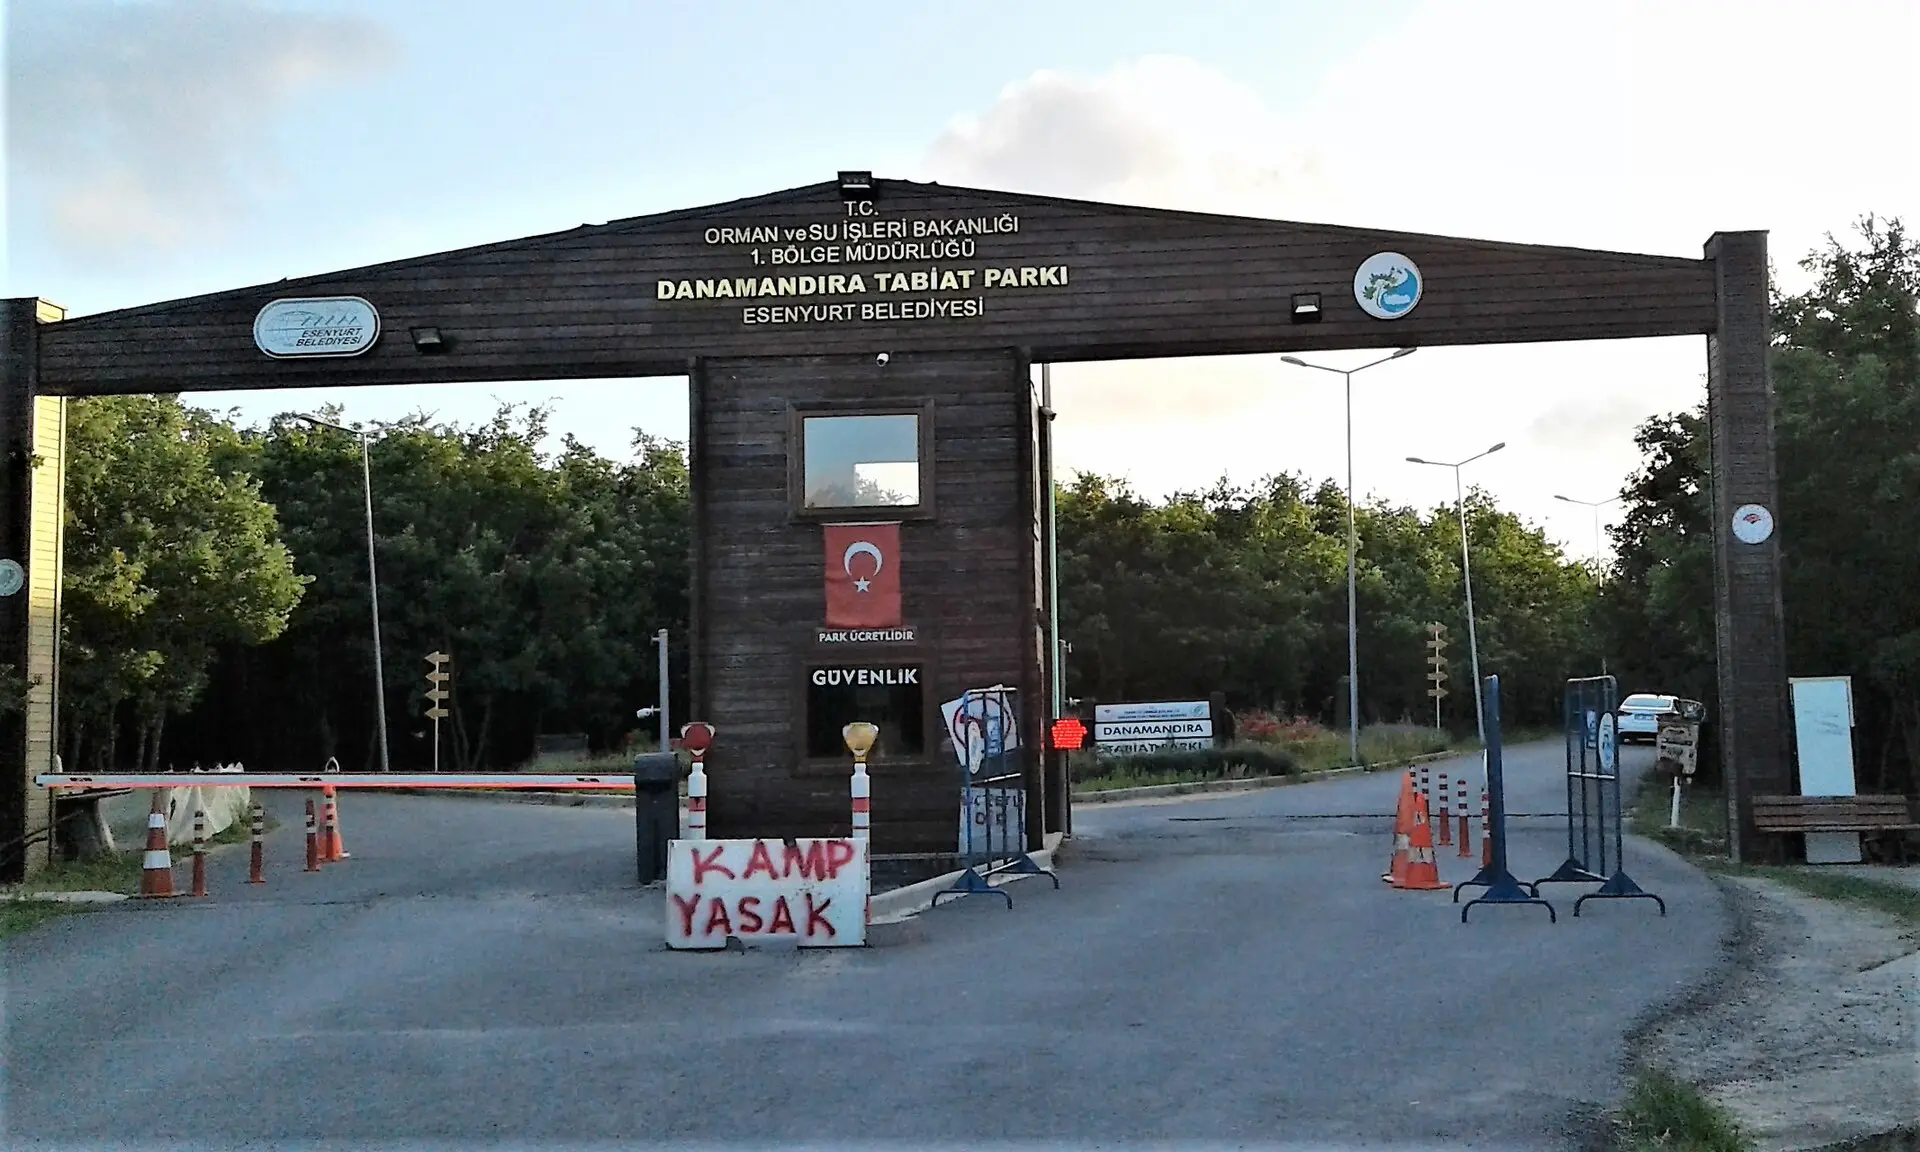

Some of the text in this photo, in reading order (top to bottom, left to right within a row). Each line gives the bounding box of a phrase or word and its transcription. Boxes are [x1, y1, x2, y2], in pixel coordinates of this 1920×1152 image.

[844, 200, 879, 217] T.C.
[704, 213, 1019, 244] ORMAN ve SU İŞLERİ BAKANLIĞI
[750, 238, 976, 265] 1. BÖLGE MÜDÜRLÜĞÜ
[657, 266, 1068, 300] DANAMANDIRA TABİAT PARKI
[742, 295, 984, 325] ESENYURT BELEDİYESİ
[302, 328, 362, 338] ESENYURT
[819, 632, 848, 643] PARK
[1103, 723, 1204, 736] DANAMANDIRA
[690, 840, 855, 884] KAMP
[672, 892, 837, 936] YASAK
